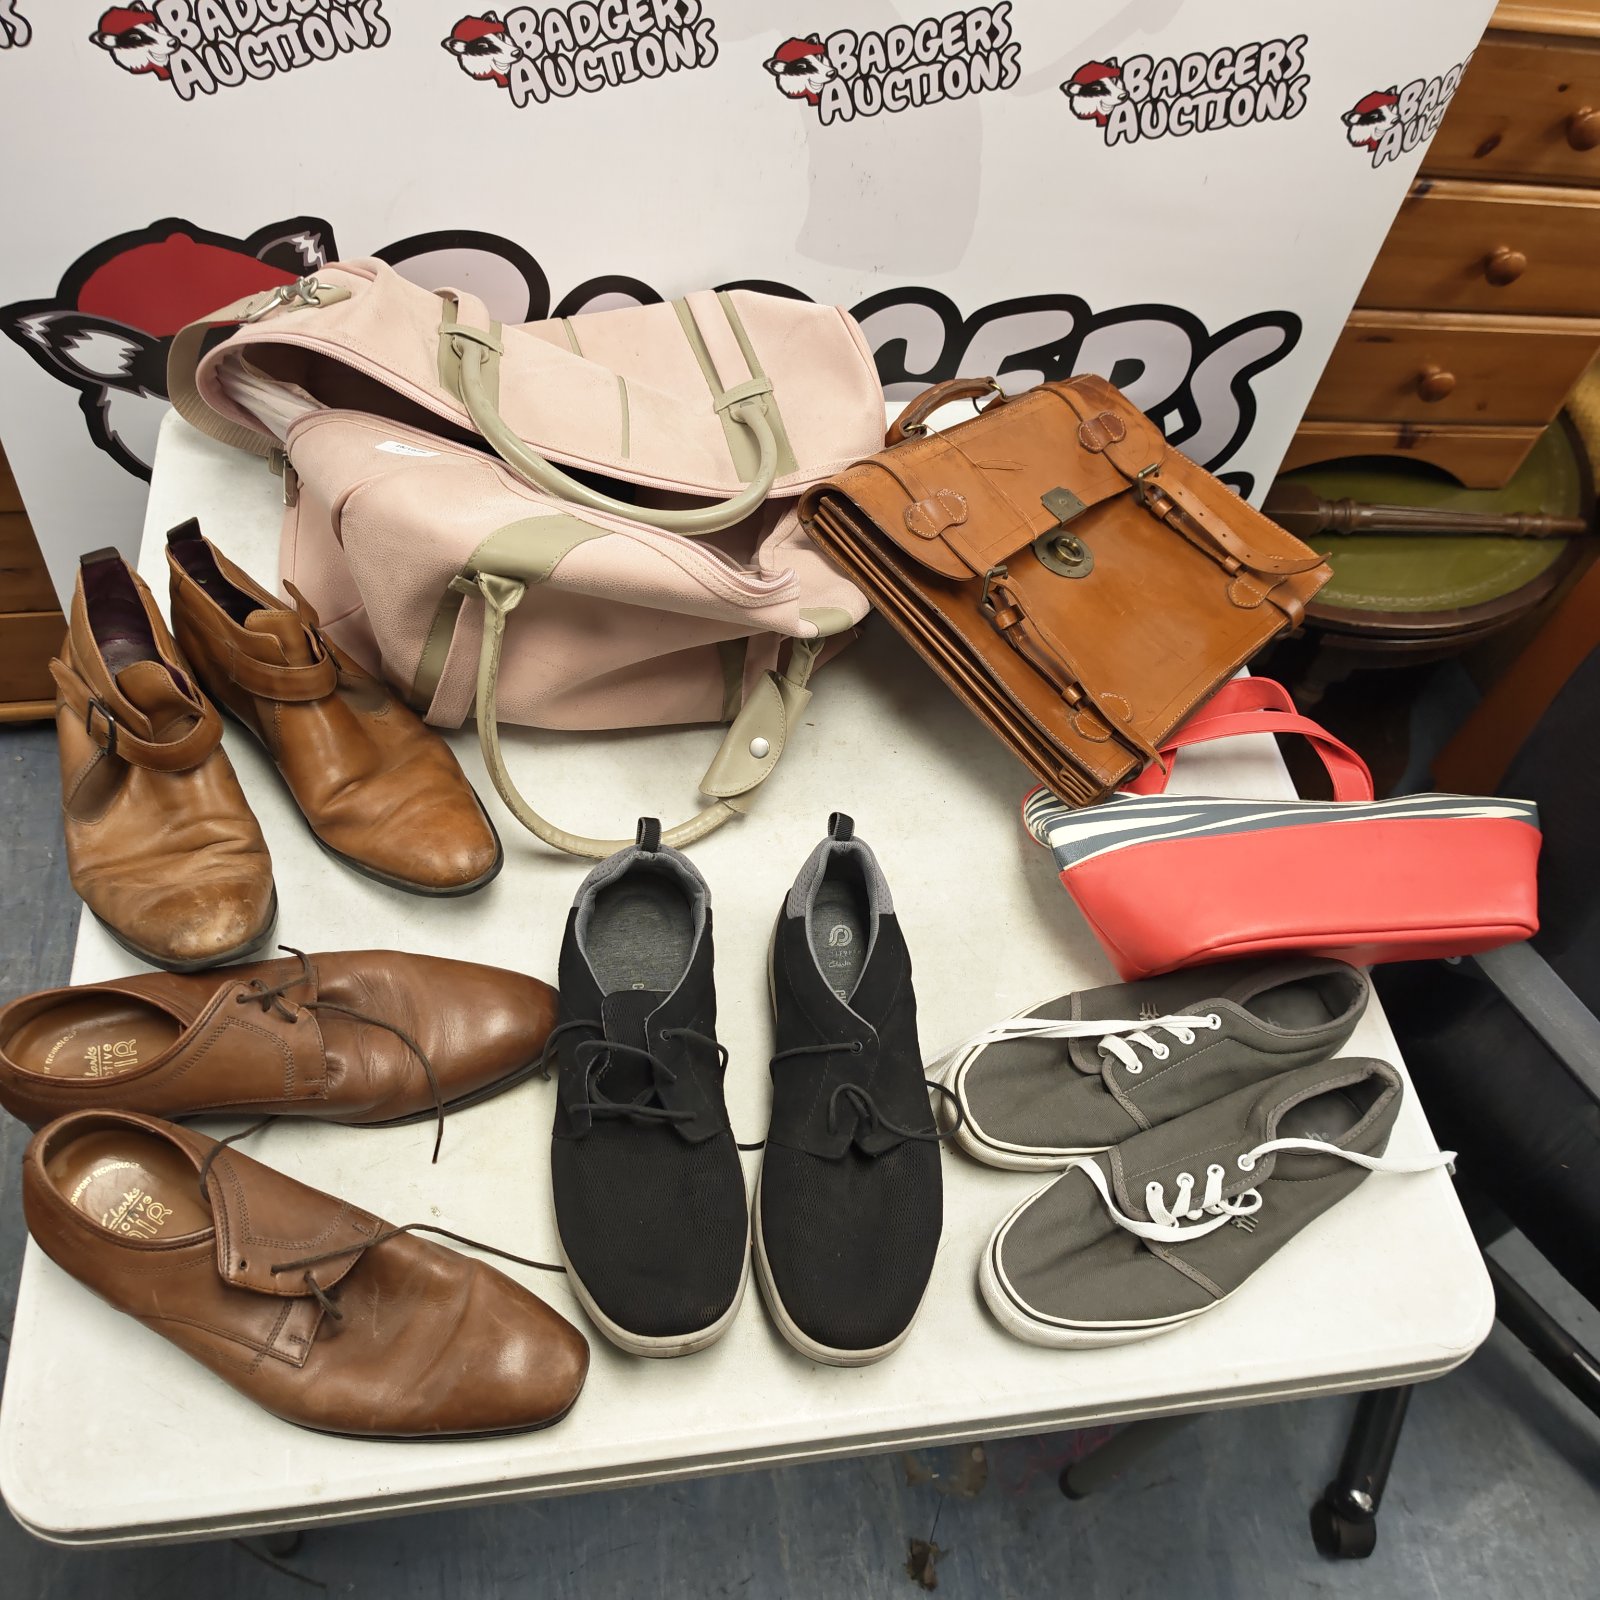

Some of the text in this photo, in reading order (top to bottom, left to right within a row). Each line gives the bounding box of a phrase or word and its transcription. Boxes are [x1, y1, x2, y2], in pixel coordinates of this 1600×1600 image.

[153, 0, 361, 49] BADG
[169, 0, 391, 101] AUCTIONS
[824, 1, 1012, 81] BADGERS
[508, 18, 718, 108] AUCTIONS
[818, 42, 1021, 126] AUCTIONS
[1121, 34, 1308, 103] BADGERS
[1398, 53, 1473, 124] BAD
[1104, 74, 1310, 147] AUCTIONS
[84, 1046, 98, 1077] larks
[113, 1038, 138, 1074] IR
[70, 1176, 92, 1205] OMFORT
